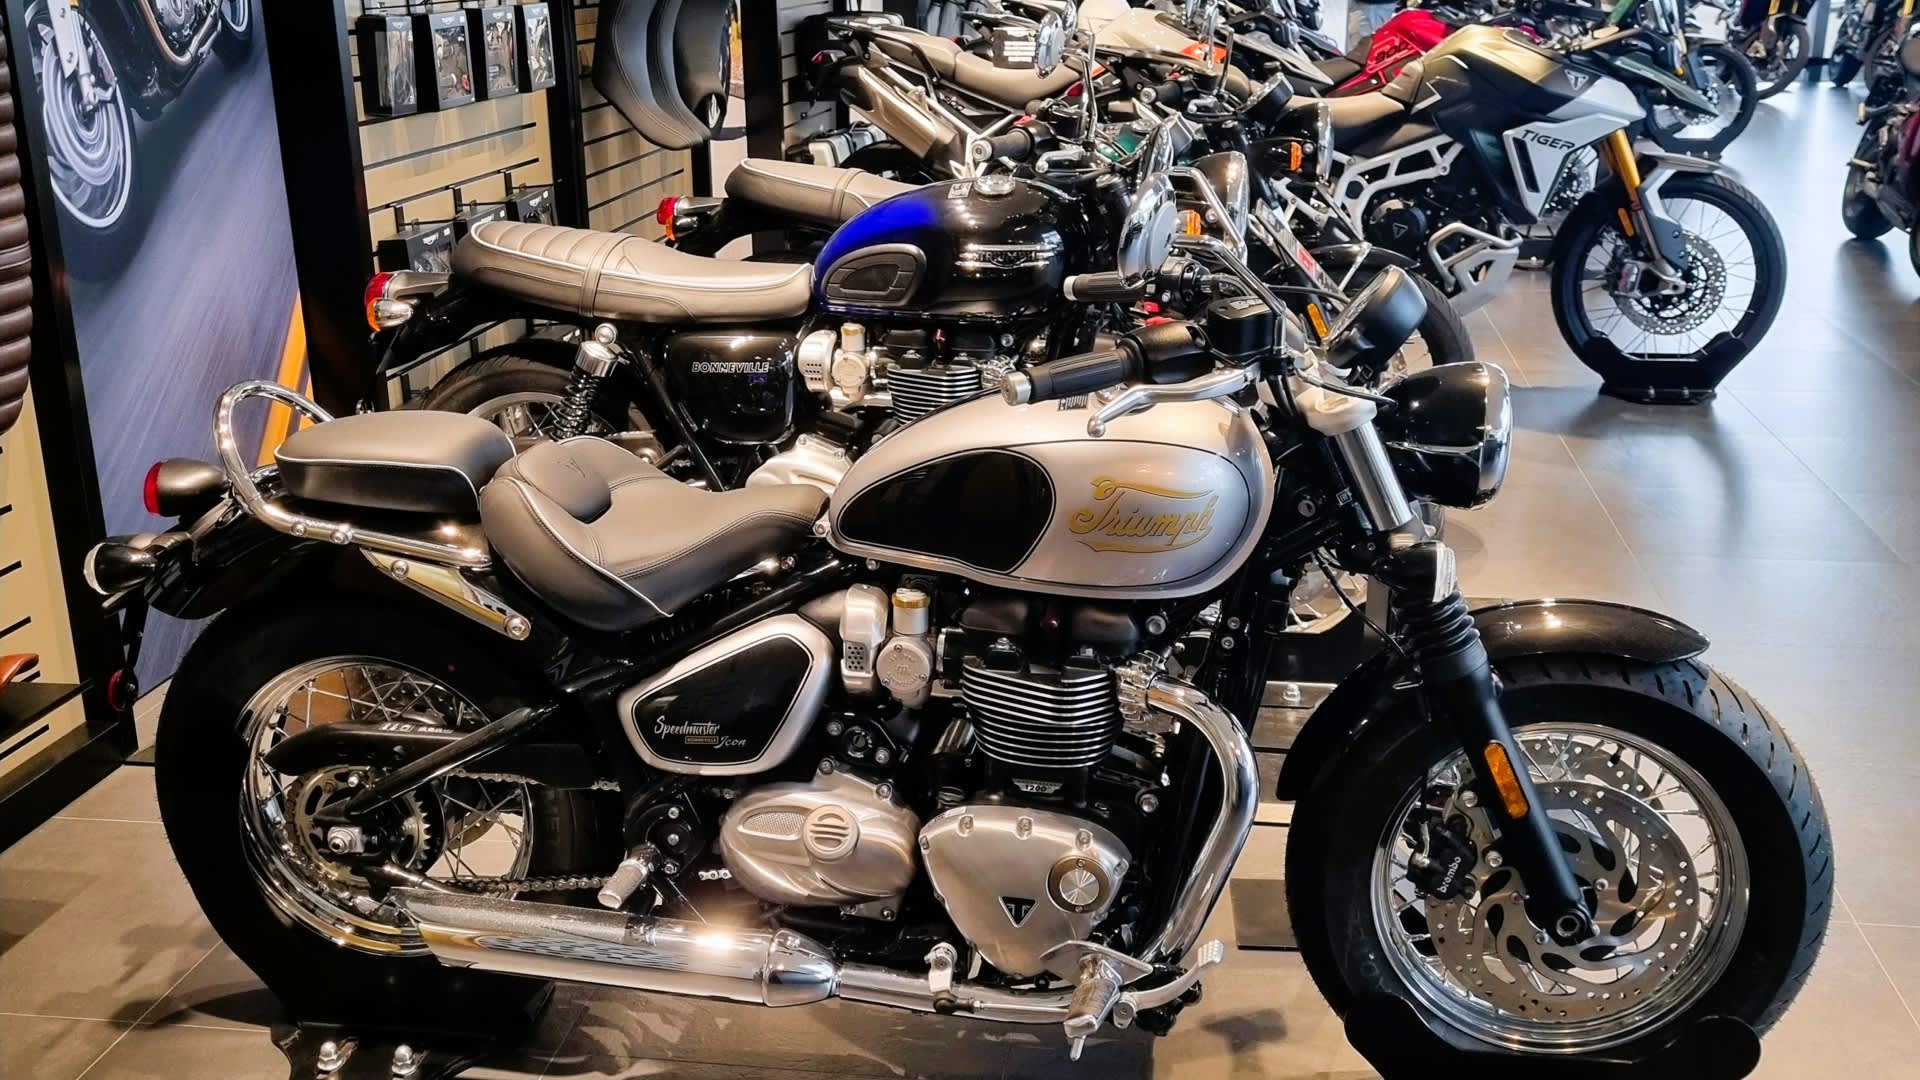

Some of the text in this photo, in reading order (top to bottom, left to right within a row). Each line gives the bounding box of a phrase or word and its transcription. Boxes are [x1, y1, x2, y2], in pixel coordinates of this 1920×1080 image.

[1521, 129, 1576, 150] TIGER
[691, 361, 770, 373] BONNEVILLE
[1068, 475, 1219, 553] Triumph
[654, 715, 720, 739] Speedmaster
[713, 735, 747, 749] Icon
[1436, 856, 1462, 893] brembo
